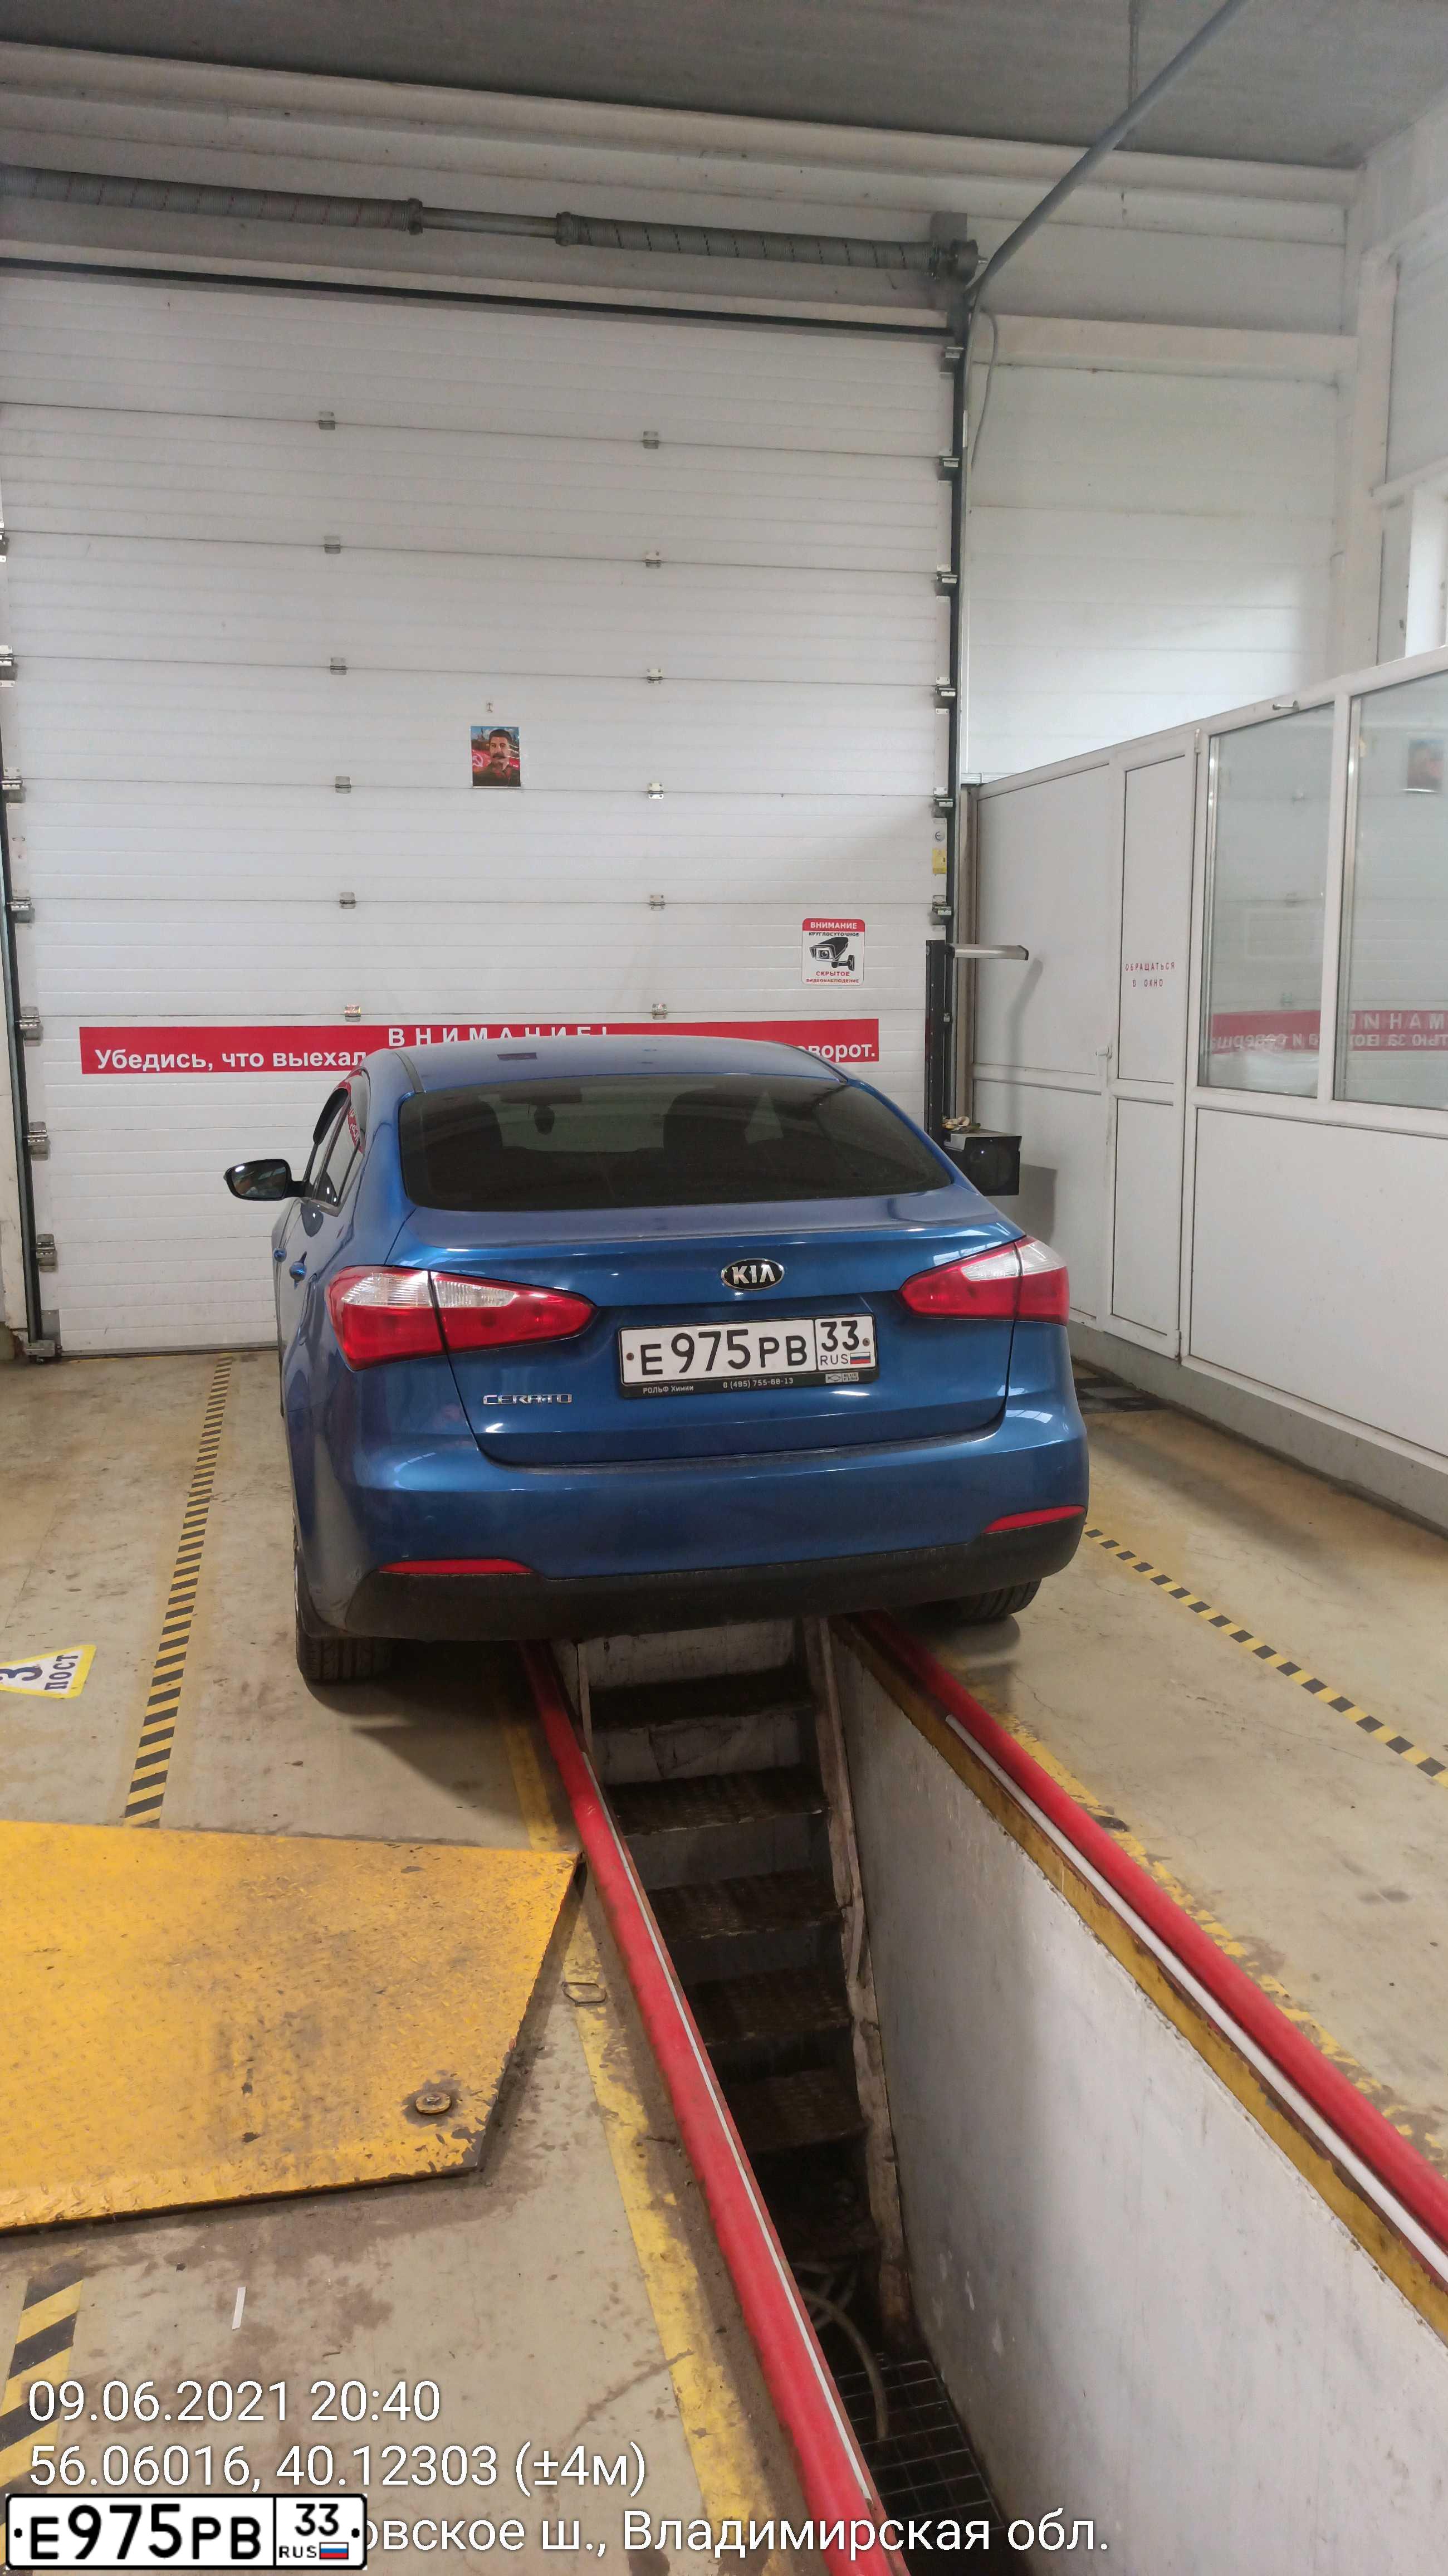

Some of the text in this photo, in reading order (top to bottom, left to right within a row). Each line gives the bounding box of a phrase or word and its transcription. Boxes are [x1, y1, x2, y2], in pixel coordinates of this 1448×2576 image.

[1125, 962, 1175, 971] ОБРАЩАТЬСЯ
[95, 1049, 213, 1071] Убедись,
[222, 1051, 264, 1067] что
[732, 1264, 776, 1284] KIA
[640, 1320, 859, 1375] Е975РВ 33
[820, 1353, 848, 1365] RUS
[483, 1394, 573, 1404] CERATO
